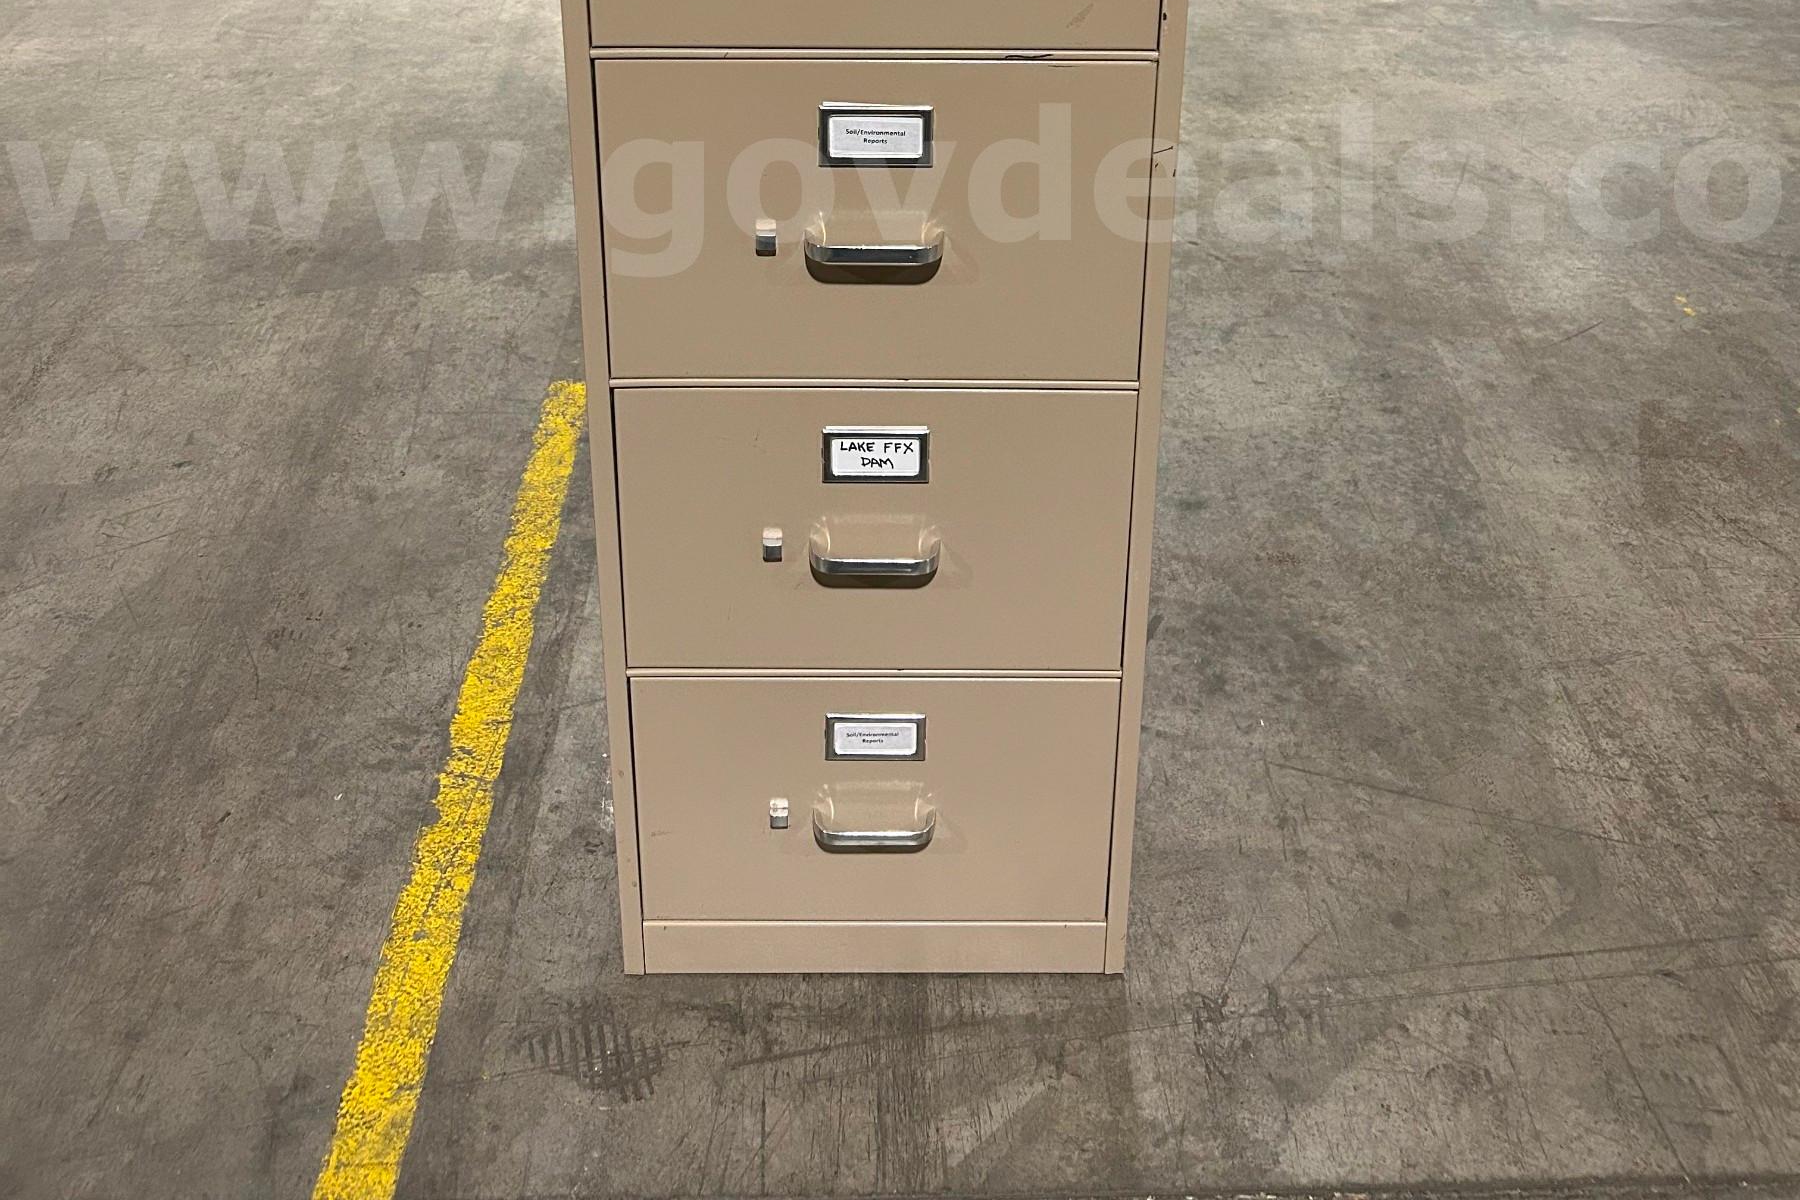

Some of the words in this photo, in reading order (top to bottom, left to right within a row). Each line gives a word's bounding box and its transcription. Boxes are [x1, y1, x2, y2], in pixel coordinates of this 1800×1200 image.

[845, 128, 906, 137] Soil/Environmental
[840, 441, 875, 453] LAKE
[883, 441, 914, 454] FFX
[861, 456, 894, 470] DAM
